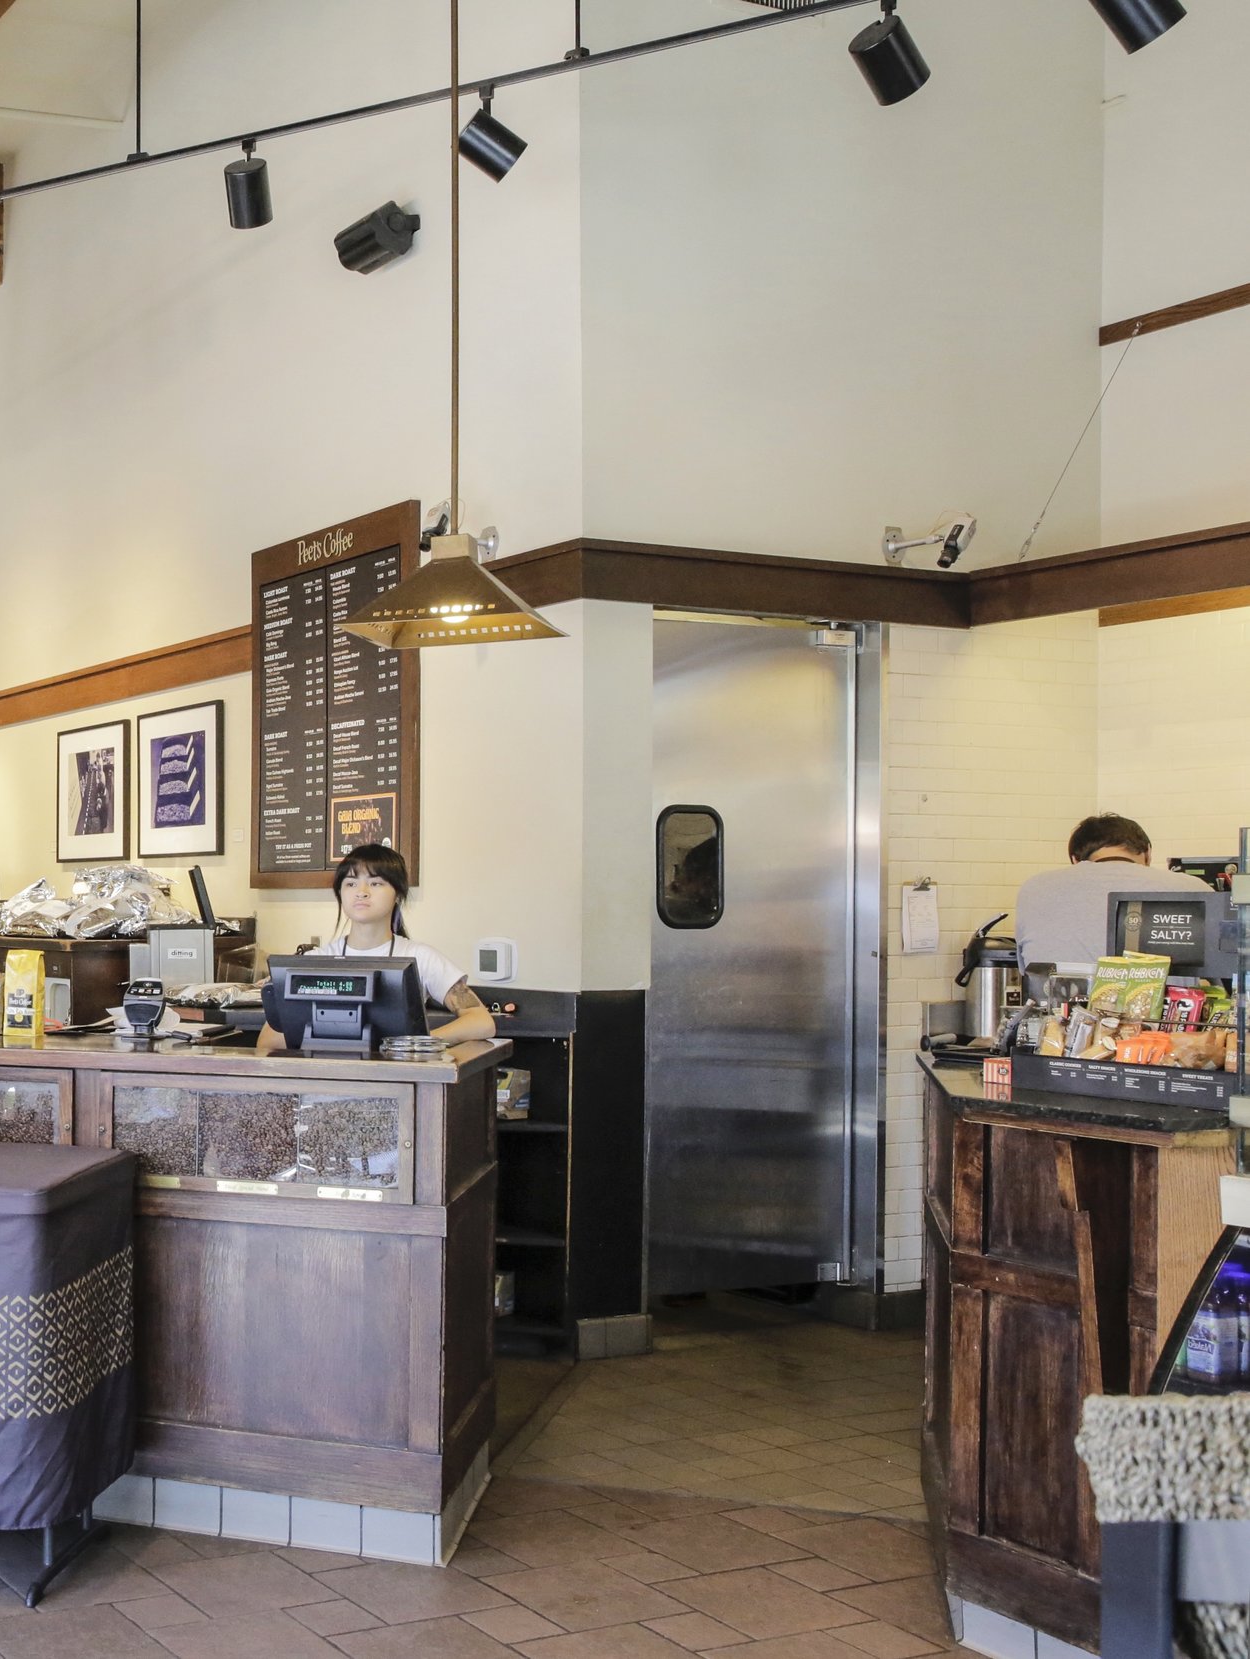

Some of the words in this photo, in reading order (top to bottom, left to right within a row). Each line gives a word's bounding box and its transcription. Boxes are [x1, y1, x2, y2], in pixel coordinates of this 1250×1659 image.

[297, 540, 321, 566] Peet's
[323, 528, 353, 558] Coffee
[353, 808, 380, 820] ORGANIC
[1152, 914, 1192, 924] SWEET
[1150, 930, 1192, 940] SALTY?
